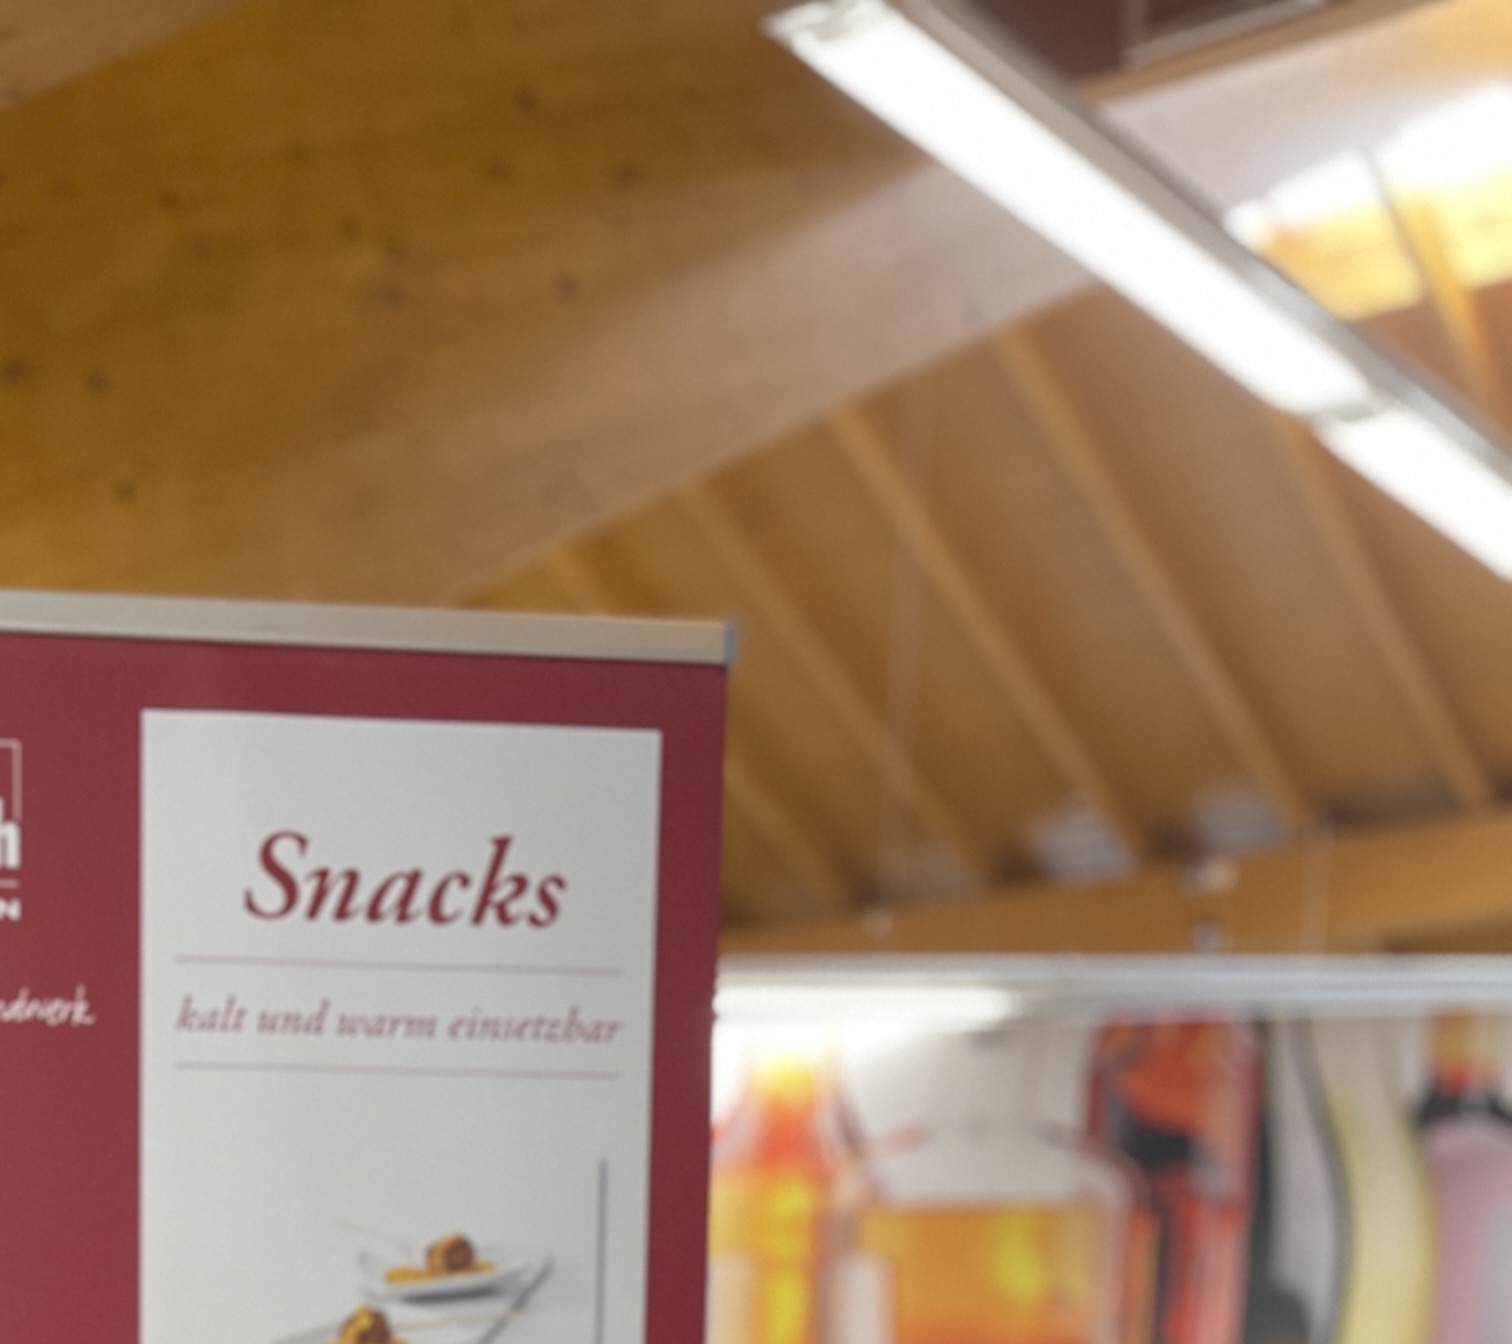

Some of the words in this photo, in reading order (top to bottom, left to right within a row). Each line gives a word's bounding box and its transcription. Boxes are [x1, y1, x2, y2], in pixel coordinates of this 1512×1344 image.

[242, 830, 567, 928] Snacks
[175, 994, 248, 1034] kalt
[257, 1000, 330, 1037] und
[336, 1015, 437, 1042] warm
[447, 1005, 624, 1045] einsetzbar
